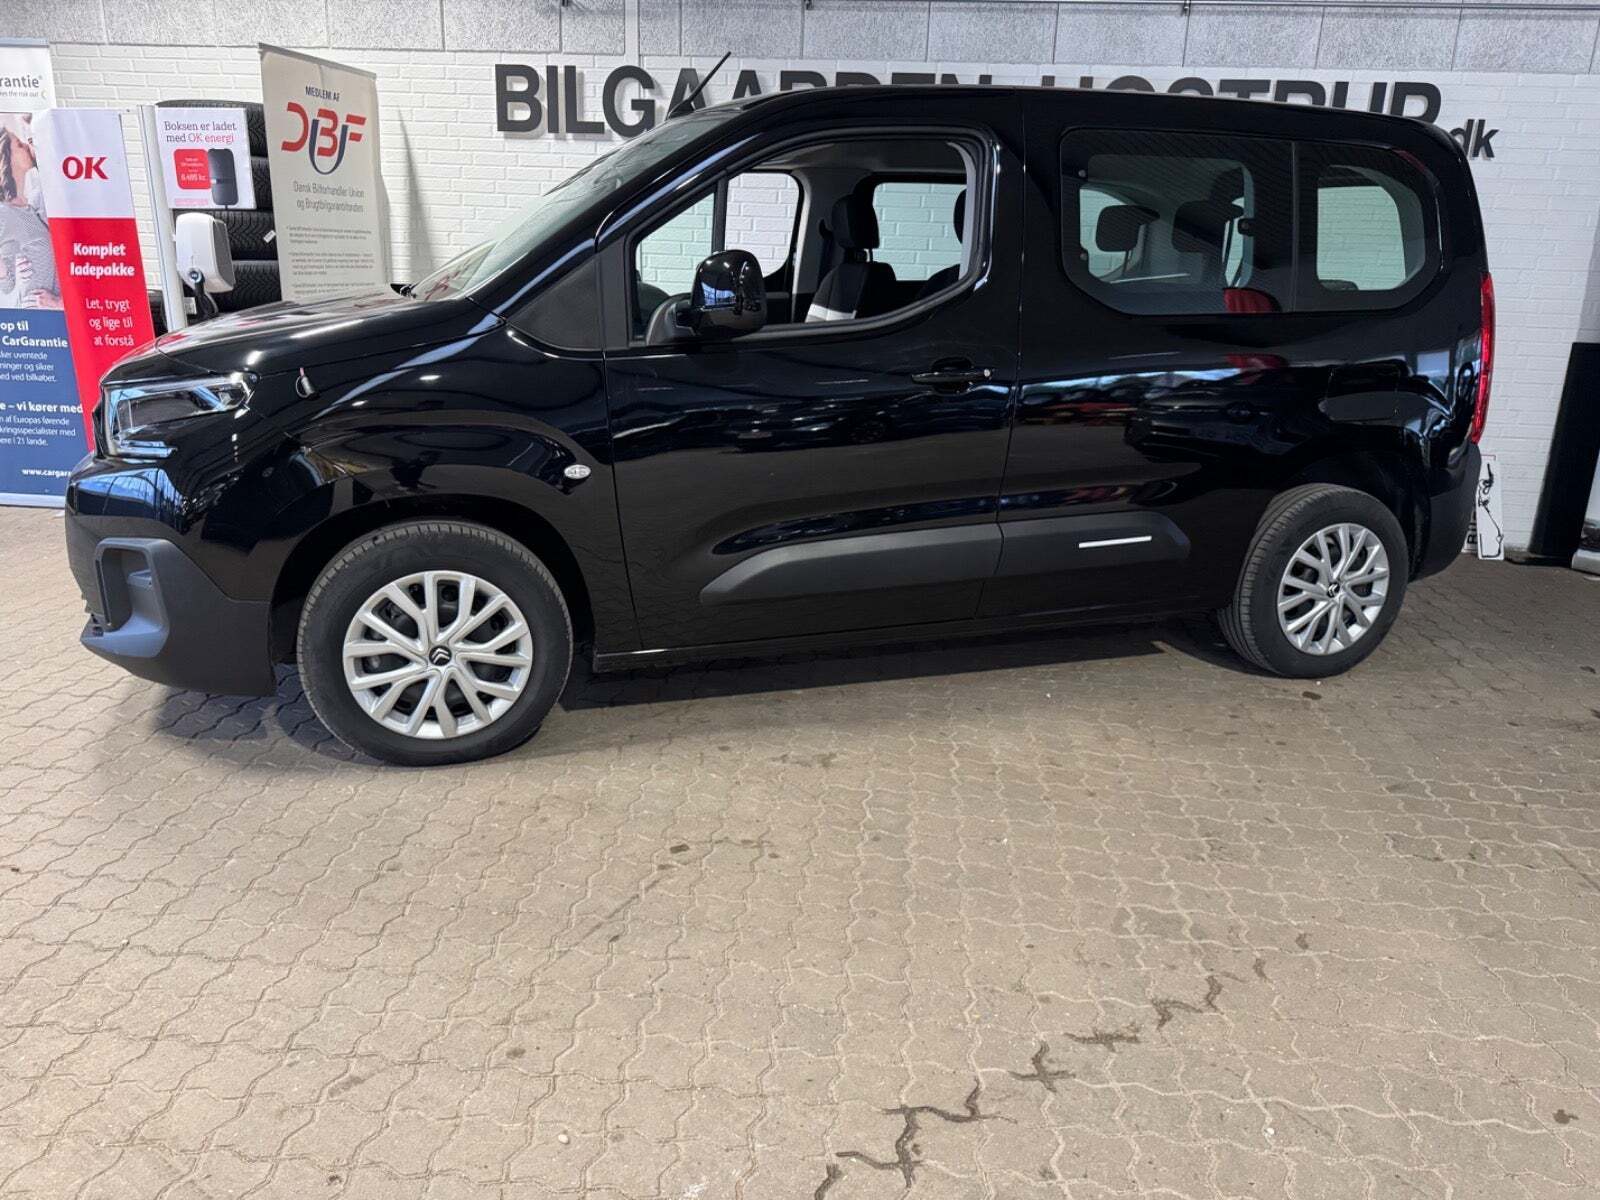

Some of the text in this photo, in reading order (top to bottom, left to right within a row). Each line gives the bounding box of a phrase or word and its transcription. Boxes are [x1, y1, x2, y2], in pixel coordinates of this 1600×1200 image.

[164, 120, 237, 131] Boksen er ladet
[166, 132, 235, 145] med OK energi
[62, 156, 109, 180] OK
[73, 242, 126, 259] Komplet
[70, 262, 135, 279] ladepakke
[85, 298, 130, 312] Let, trygt
[17, 320, 29, 331] til
[88, 316, 133, 331] og lige til
[2, 335, 68, 348] CarGarantie
[93, 333, 134, 346] at forstå
[16, 401, 27, 411] vi
[28, 401, 59, 413] kører
[60, 403, 84, 414] med
[59, 428, 76, 437] med
